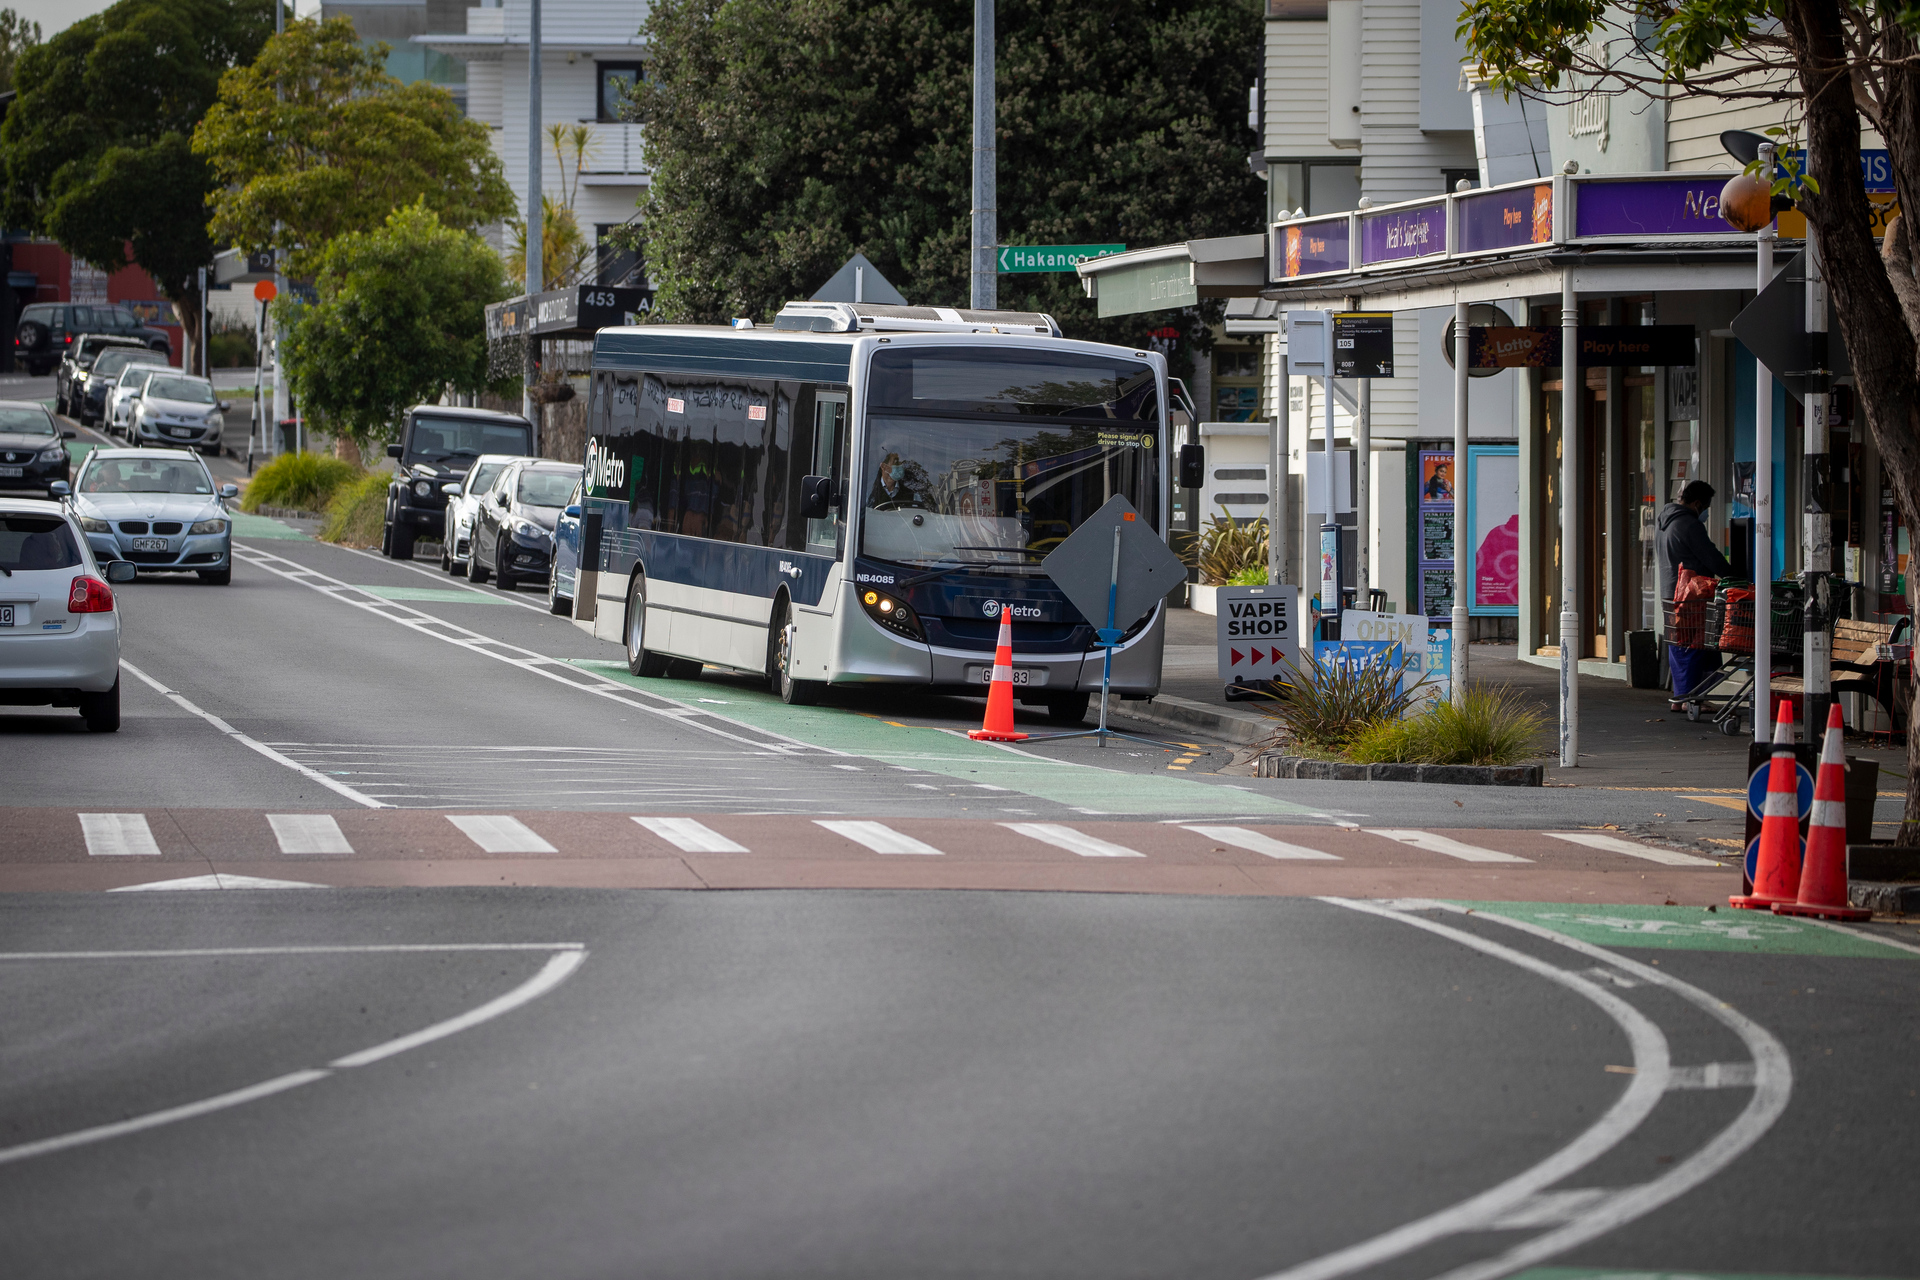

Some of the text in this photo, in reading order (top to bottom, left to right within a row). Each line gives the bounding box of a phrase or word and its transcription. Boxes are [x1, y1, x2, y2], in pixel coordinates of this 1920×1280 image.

[1537, 197, 1548, 219] Lotto
[1682, 190, 1724, 220] Ne
[1503, 207, 1513, 229] Play
[1512, 207, 1522, 224] here
[1386, 216, 1404, 249] Neal's
[1309, 238, 1318, 257] Play
[1317, 237, 1325, 253] here
[585, 291, 615, 307] 453
[1496, 337, 1532, 354] Lotto
[1583, 340, 1650, 356] Play here
[1672, 372, 1696, 407] VAPE
[1097, 438, 1117, 446] driver
[1126, 441, 1140, 449] stop
[596, 446, 625, 489] Metro
[134, 540, 166, 549] GMF267
[856, 573, 895, 584] NB4085
[1001, 603, 1041, 617] Metro
[1229, 602, 1286, 618] VAPE
[1228, 620, 1288, 636] SHOP
[1356, 619, 1413, 645] OPEN
[1331, 652, 1382, 681] FREE
[983, 670, 1028, 684] G83
